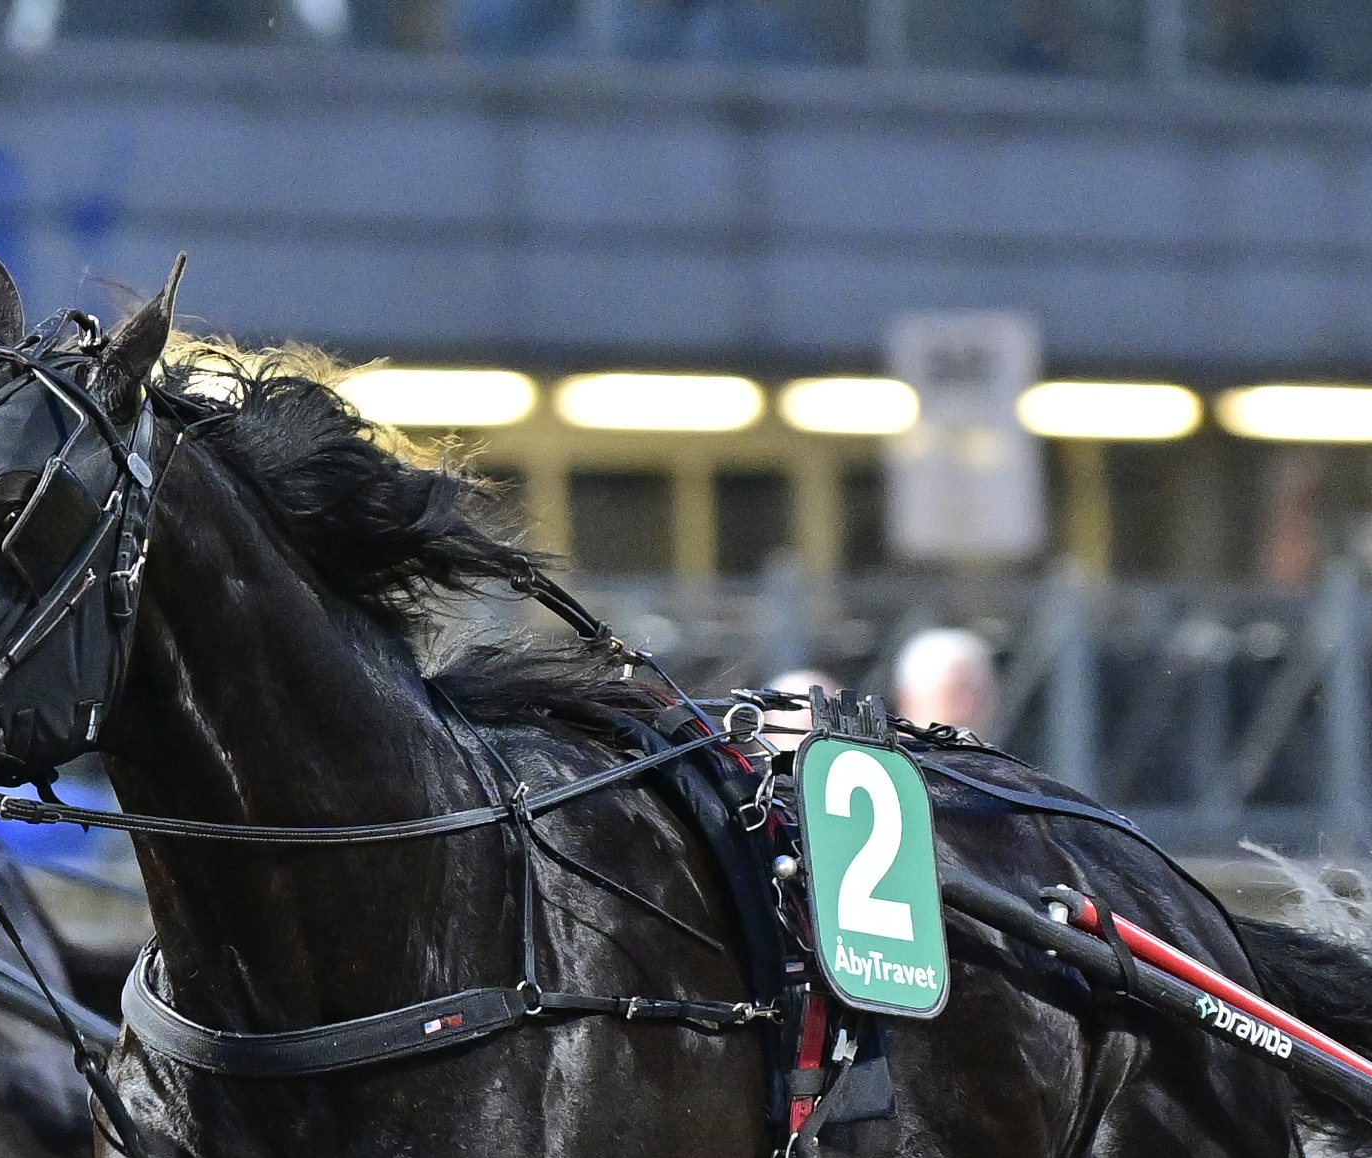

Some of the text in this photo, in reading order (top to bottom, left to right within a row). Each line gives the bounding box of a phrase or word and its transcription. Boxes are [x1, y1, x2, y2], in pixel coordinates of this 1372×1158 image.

[825, 750, 915, 942] 2
[834, 935, 938, 990] ÅbyTravet
[1214, 998, 1293, 1059] bravida
